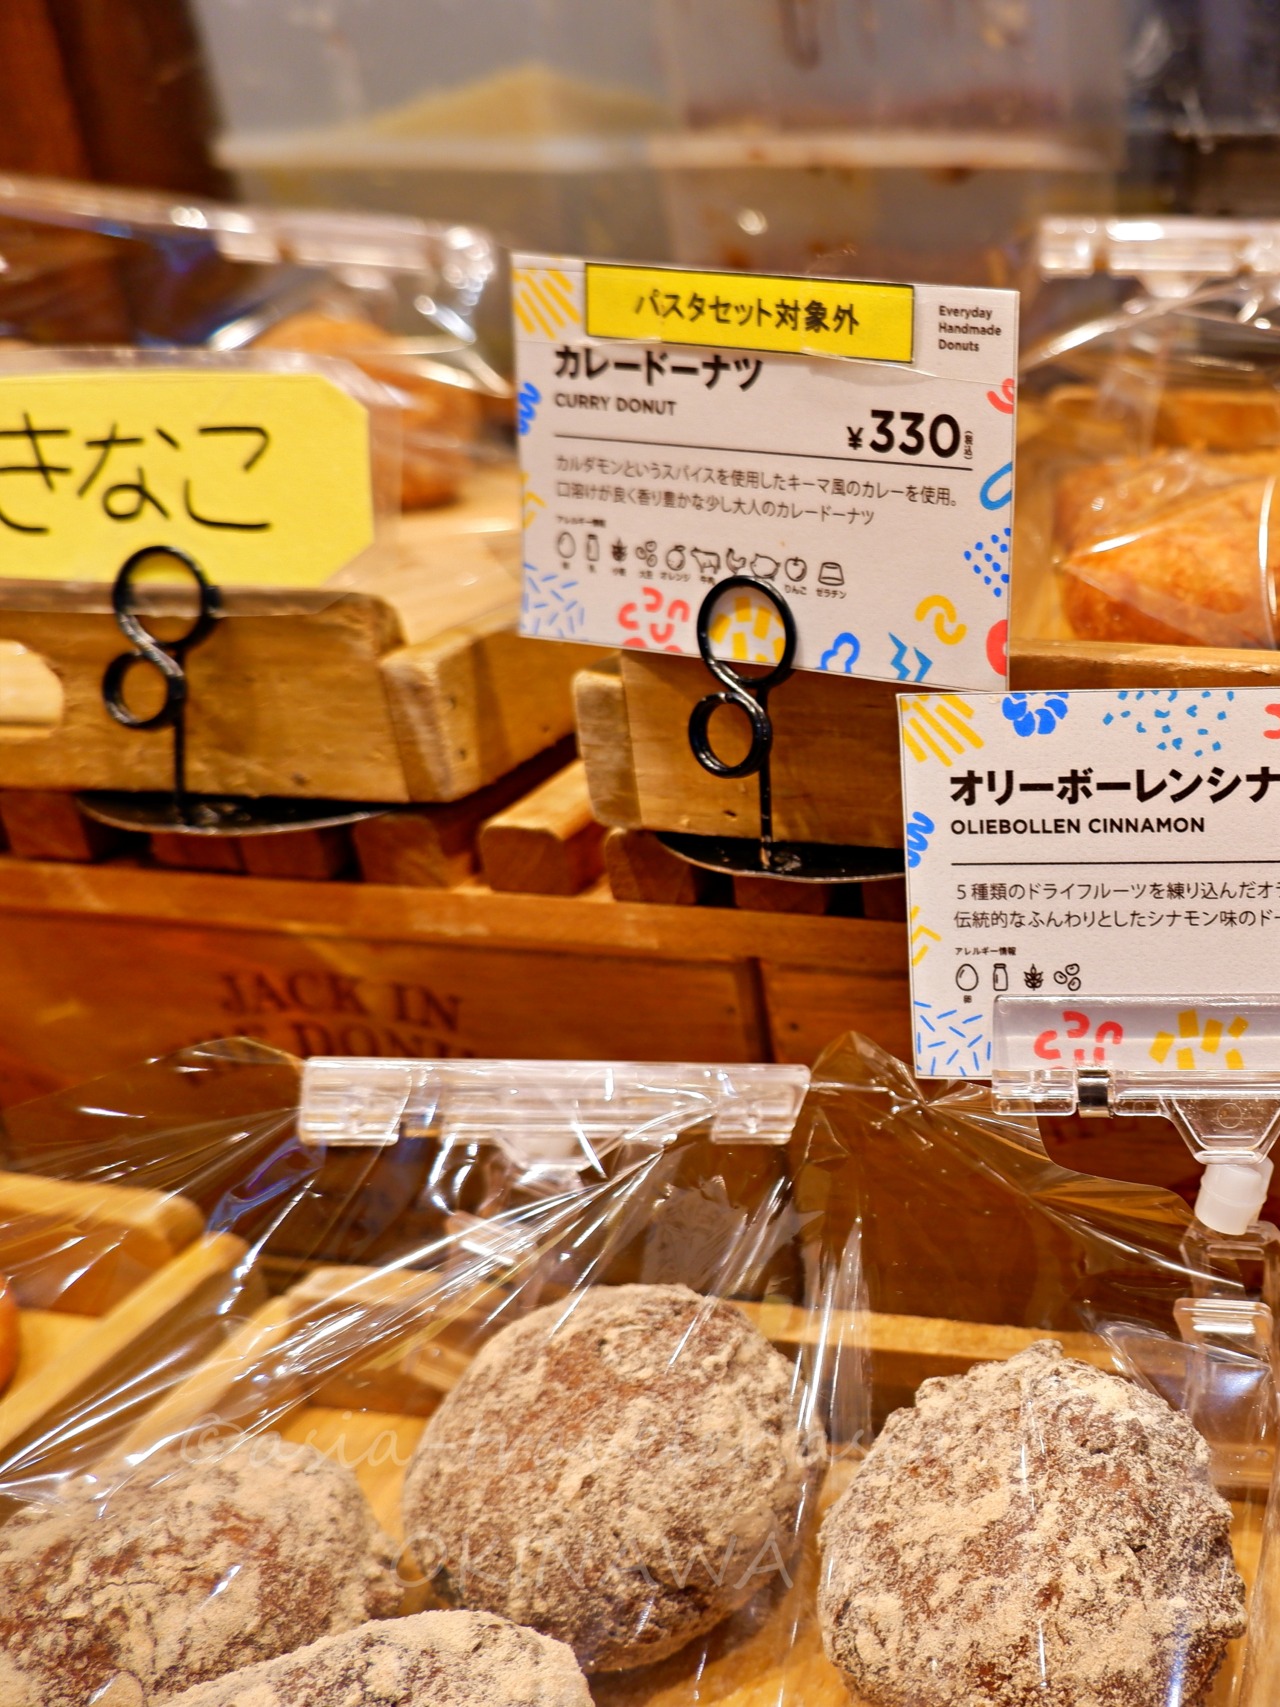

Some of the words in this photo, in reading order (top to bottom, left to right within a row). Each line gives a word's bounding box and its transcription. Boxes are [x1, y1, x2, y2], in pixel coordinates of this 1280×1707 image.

[635, 290, 860, 336] パスタセット対象外
[938, 305, 993, 321] Everyday
[938, 322, 1002, 337] Handmade
[555, 345, 764, 391] カレードーナツ
[938, 338, 981, 353] Donuts
[555, 393, 611, 412] CURRY
[616, 397, 676, 416] DONUT
[846, 409, 961, 459] ¥330
[0, 410, 273, 534] きなこ
[555, 455, 959, 508] カルダモンというスパイスを使用したキーマ風のカレーを使用。
[556, 482, 875, 526] 口溶けが良く香り豊かな少し大人のカレードーナツ
[950, 817, 1081, 835] OLIEBOLLEN
[1088, 816, 1205, 834] CINNAMON
[219, 969, 370, 1017] JACK
[388, 980, 462, 1032] IN
